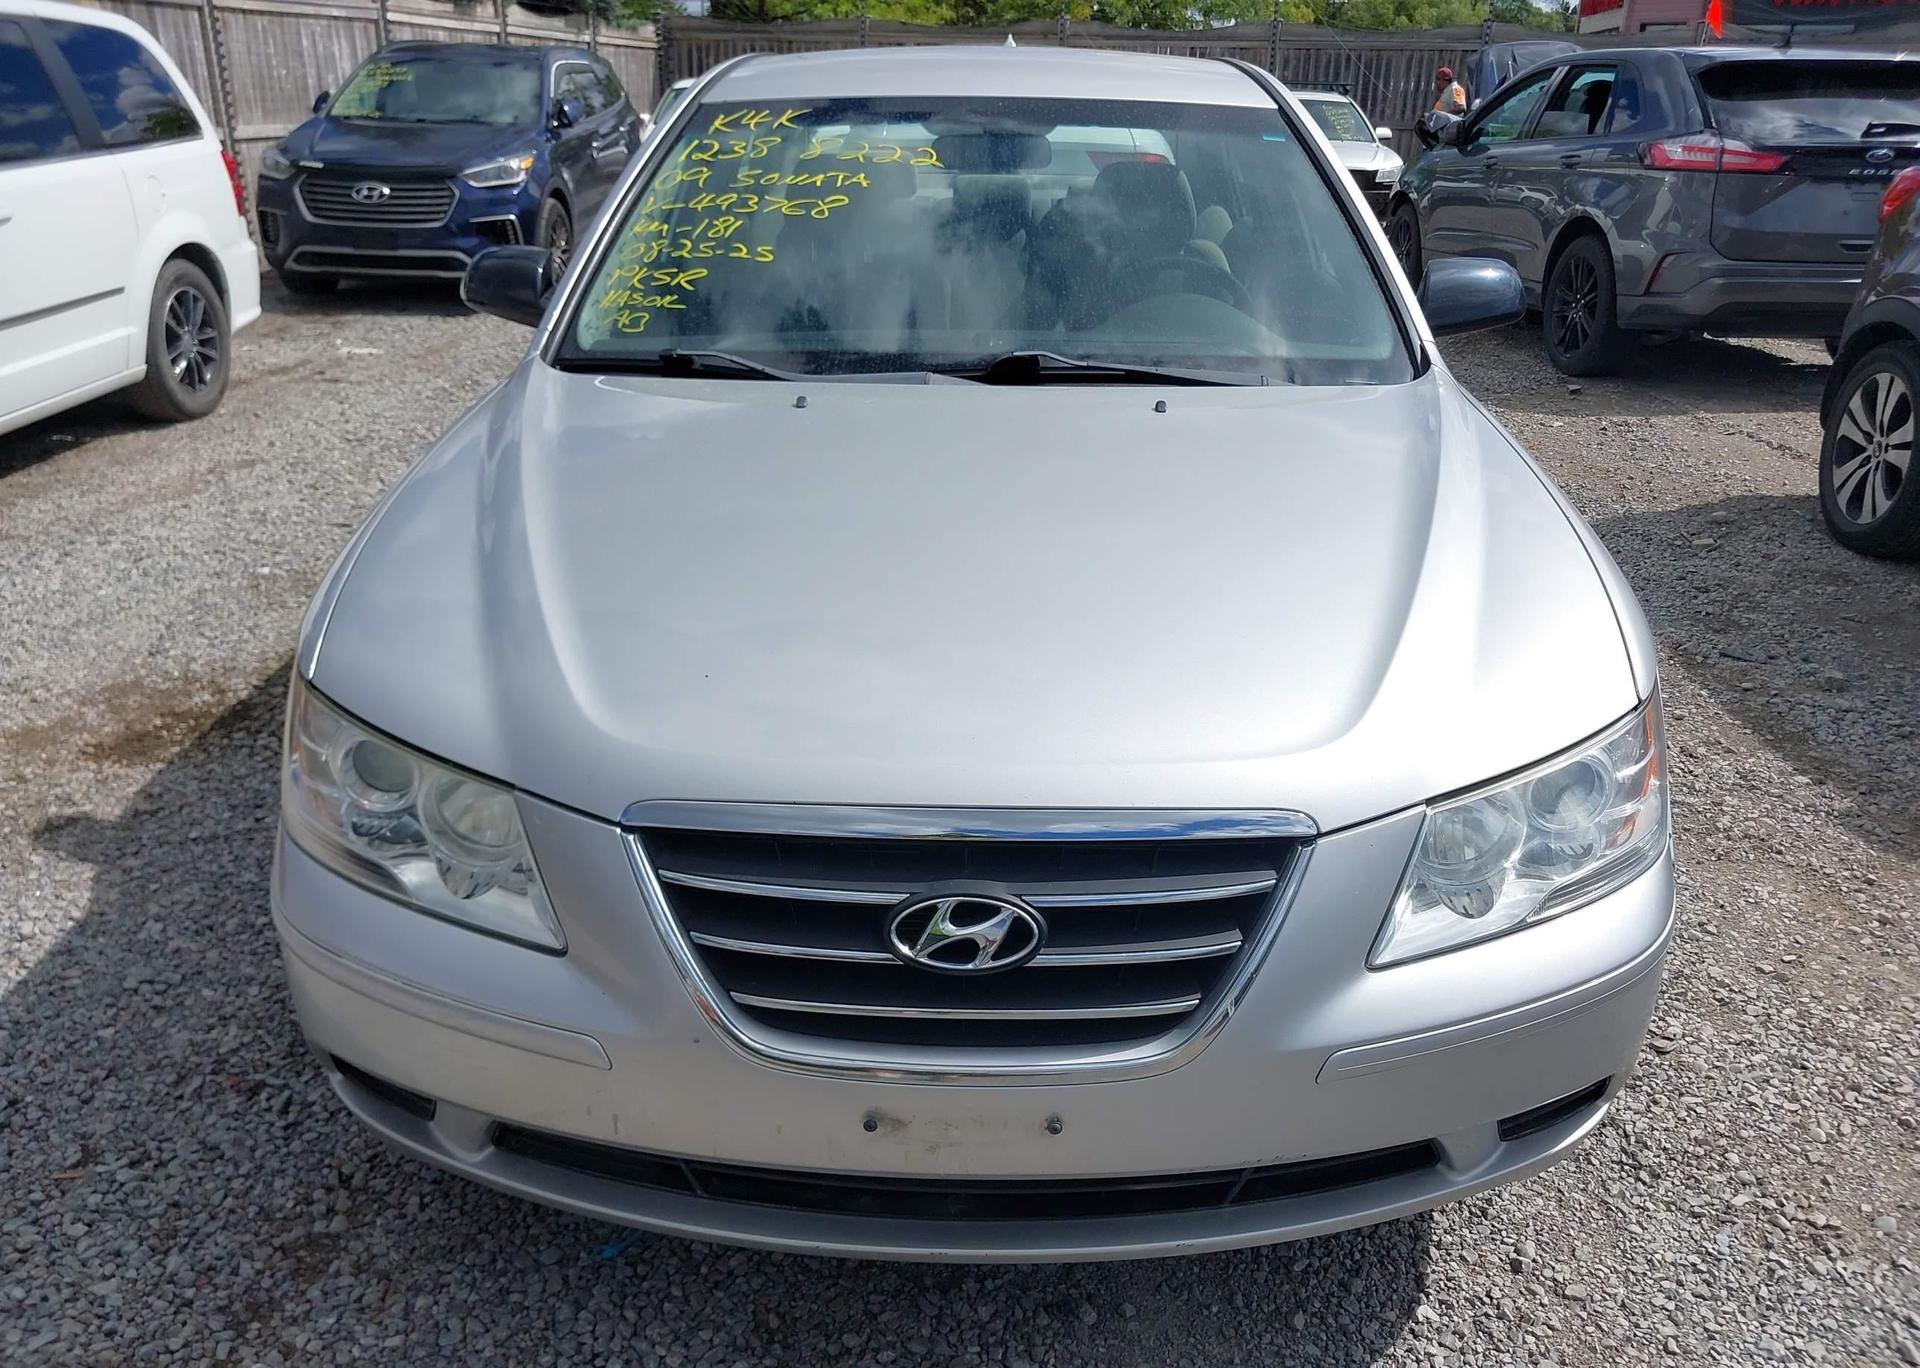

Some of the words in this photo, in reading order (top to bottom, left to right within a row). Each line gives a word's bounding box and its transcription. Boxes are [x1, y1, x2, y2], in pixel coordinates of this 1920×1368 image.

[678, 136, 782, 162] 1238
[800, 137, 944, 168] 8222
[728, 169, 871, 188] SONATA
